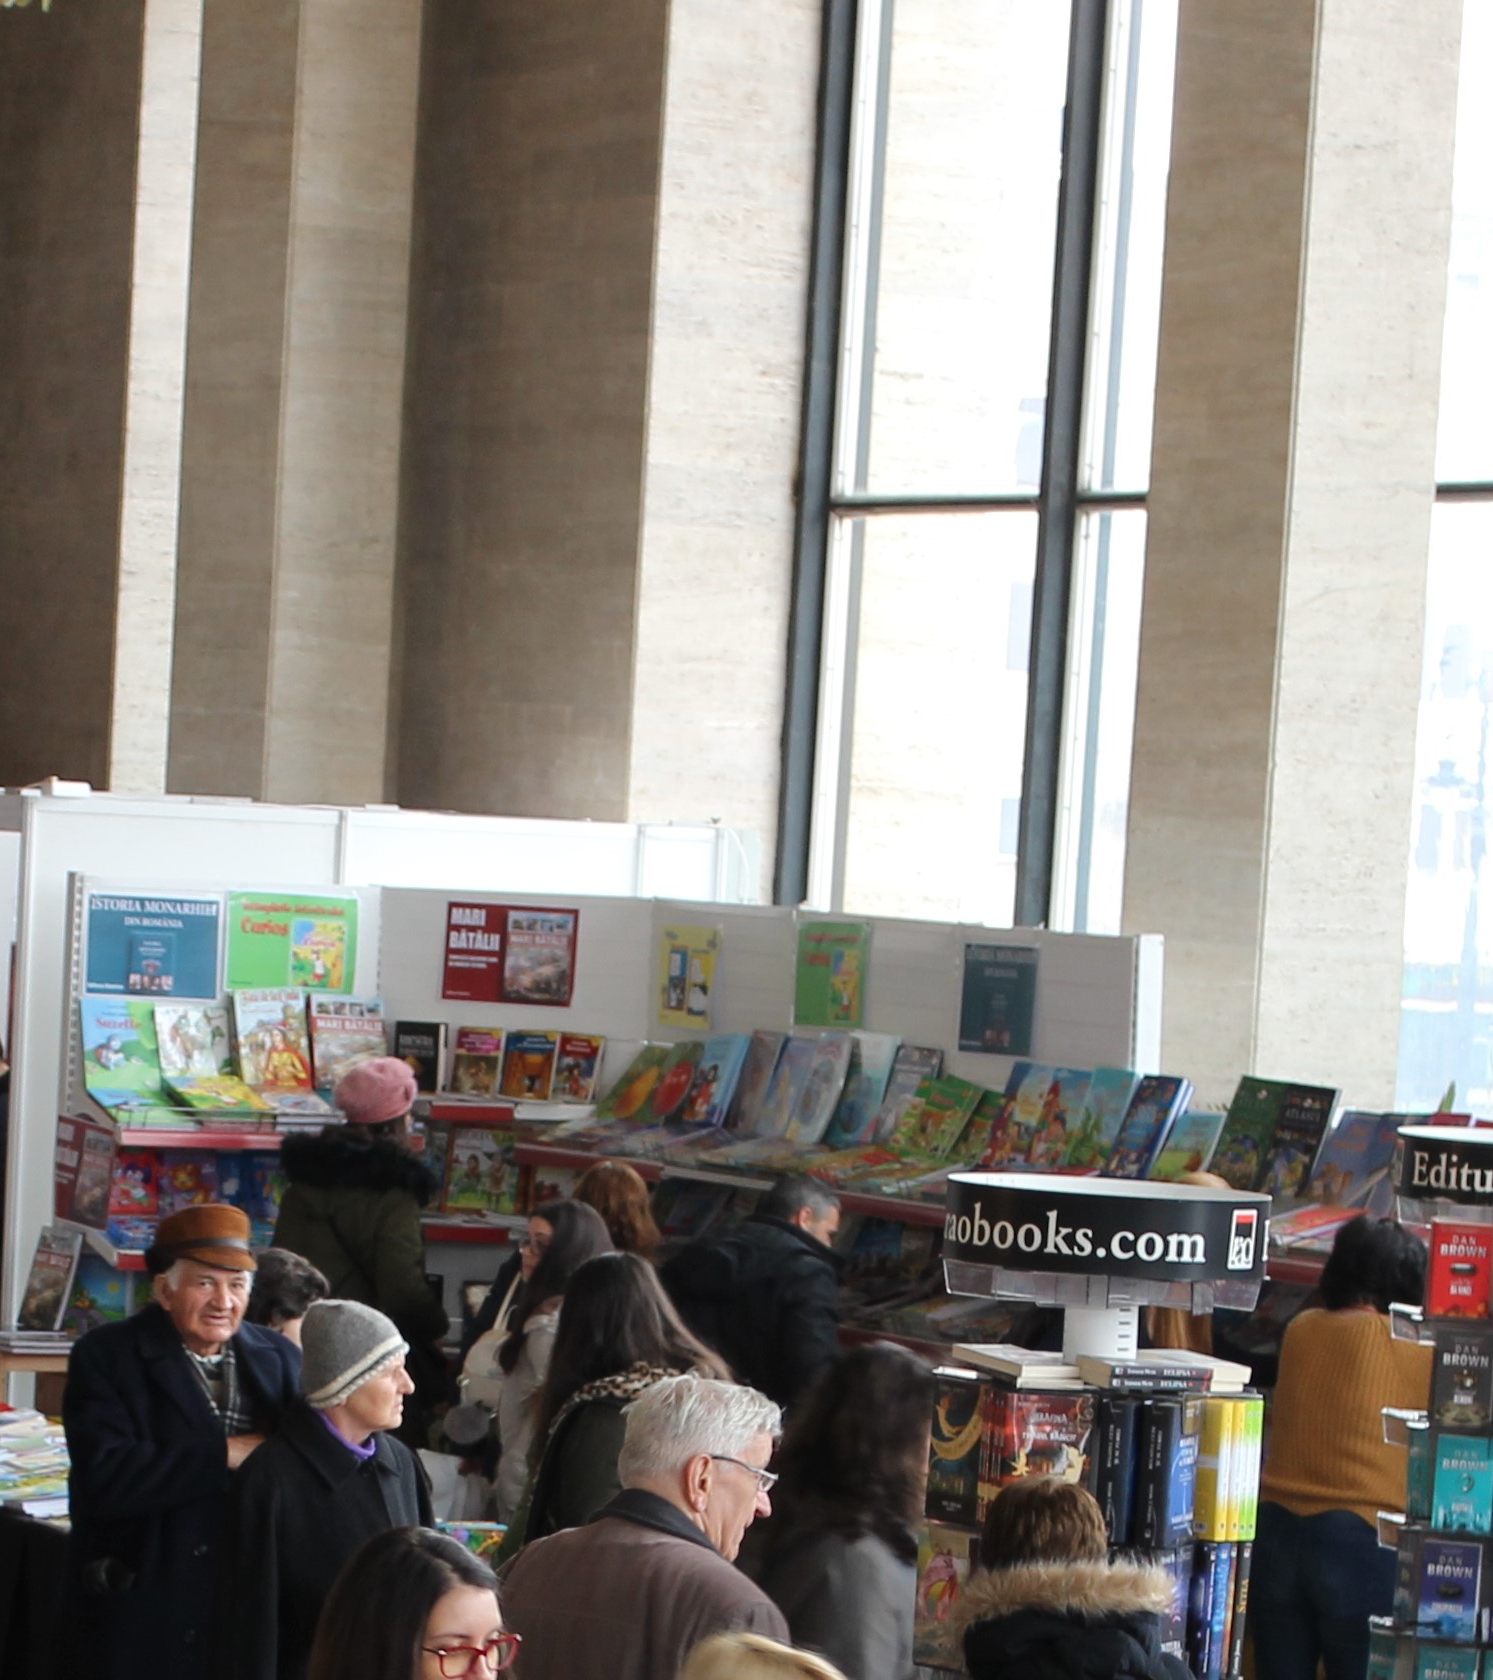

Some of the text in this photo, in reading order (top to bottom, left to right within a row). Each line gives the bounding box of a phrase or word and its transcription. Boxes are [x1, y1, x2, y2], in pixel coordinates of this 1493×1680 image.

[91, 897, 141, 912] ISTORIA
[451, 907, 486, 927] MARI
[943, 1201, 1207, 1265] raobooks.com
[1452, 1234, 1477, 1246] DAN
[1440, 1244, 1488, 1258] BROWN
[1442, 1353, 1490, 1368] BROWN
[1442, 1458, 1490, 1472] BROWN
[1438, 1555, 1463, 1566] DAN
[1426, 1563, 1474, 1579] BROWN
